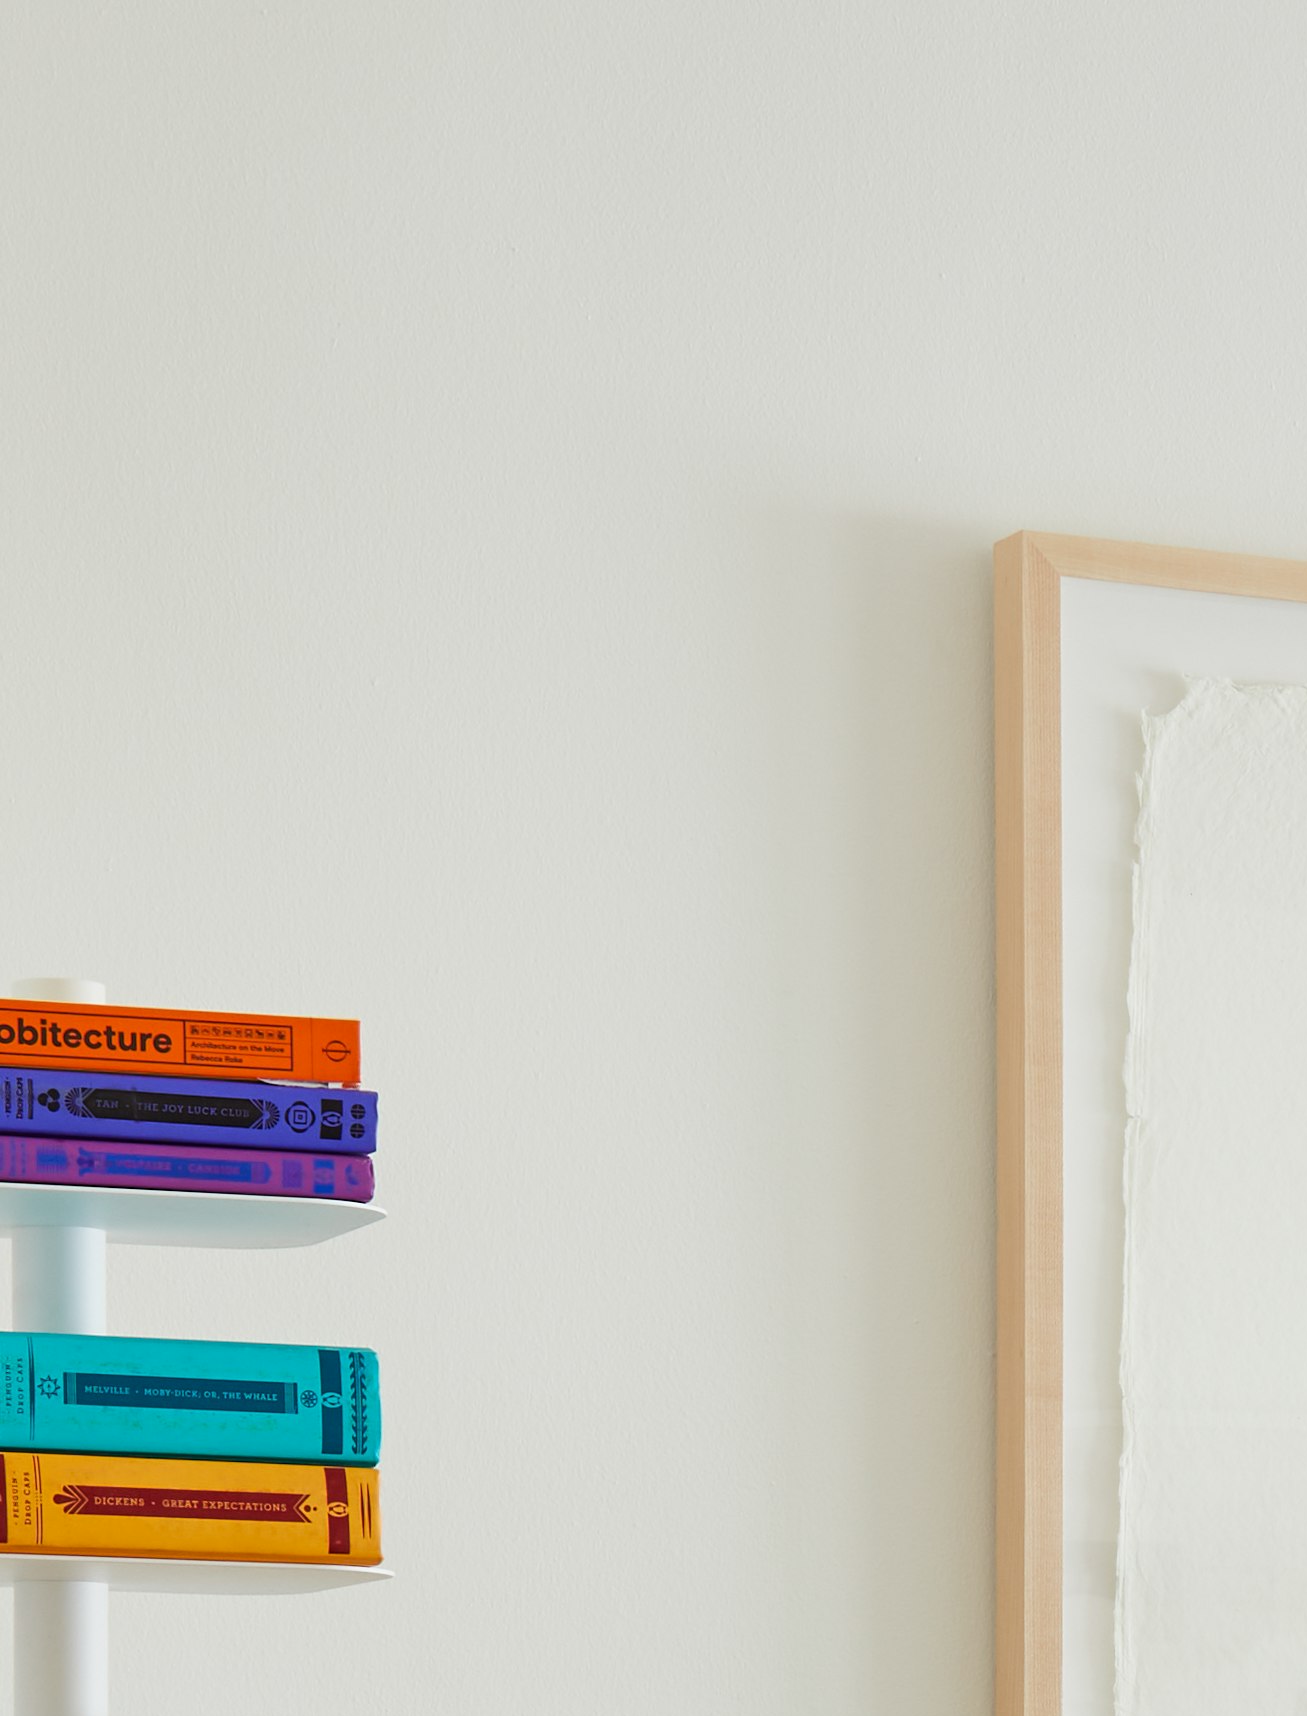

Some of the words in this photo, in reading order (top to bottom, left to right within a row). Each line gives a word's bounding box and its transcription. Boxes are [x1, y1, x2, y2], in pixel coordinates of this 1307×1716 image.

[96, 1100, 118, 1108] TAN
[137, 1102, 158, 1111] THE
[162, 1104, 184, 1113] JOY
[187, 1106, 217, 1115] LUCK
[220, 1108, 250, 1118] CLUB
[84, 1385, 130, 1395] MELVILLE
[223, 1391, 241, 1400] THE
[244, 1393, 278, 1401] WHALE
[94, 1496, 145, 1507] DICKENS
[162, 1499, 198, 1509] GREAT
[203, 1500, 287, 1512] EXPECTATIONS
